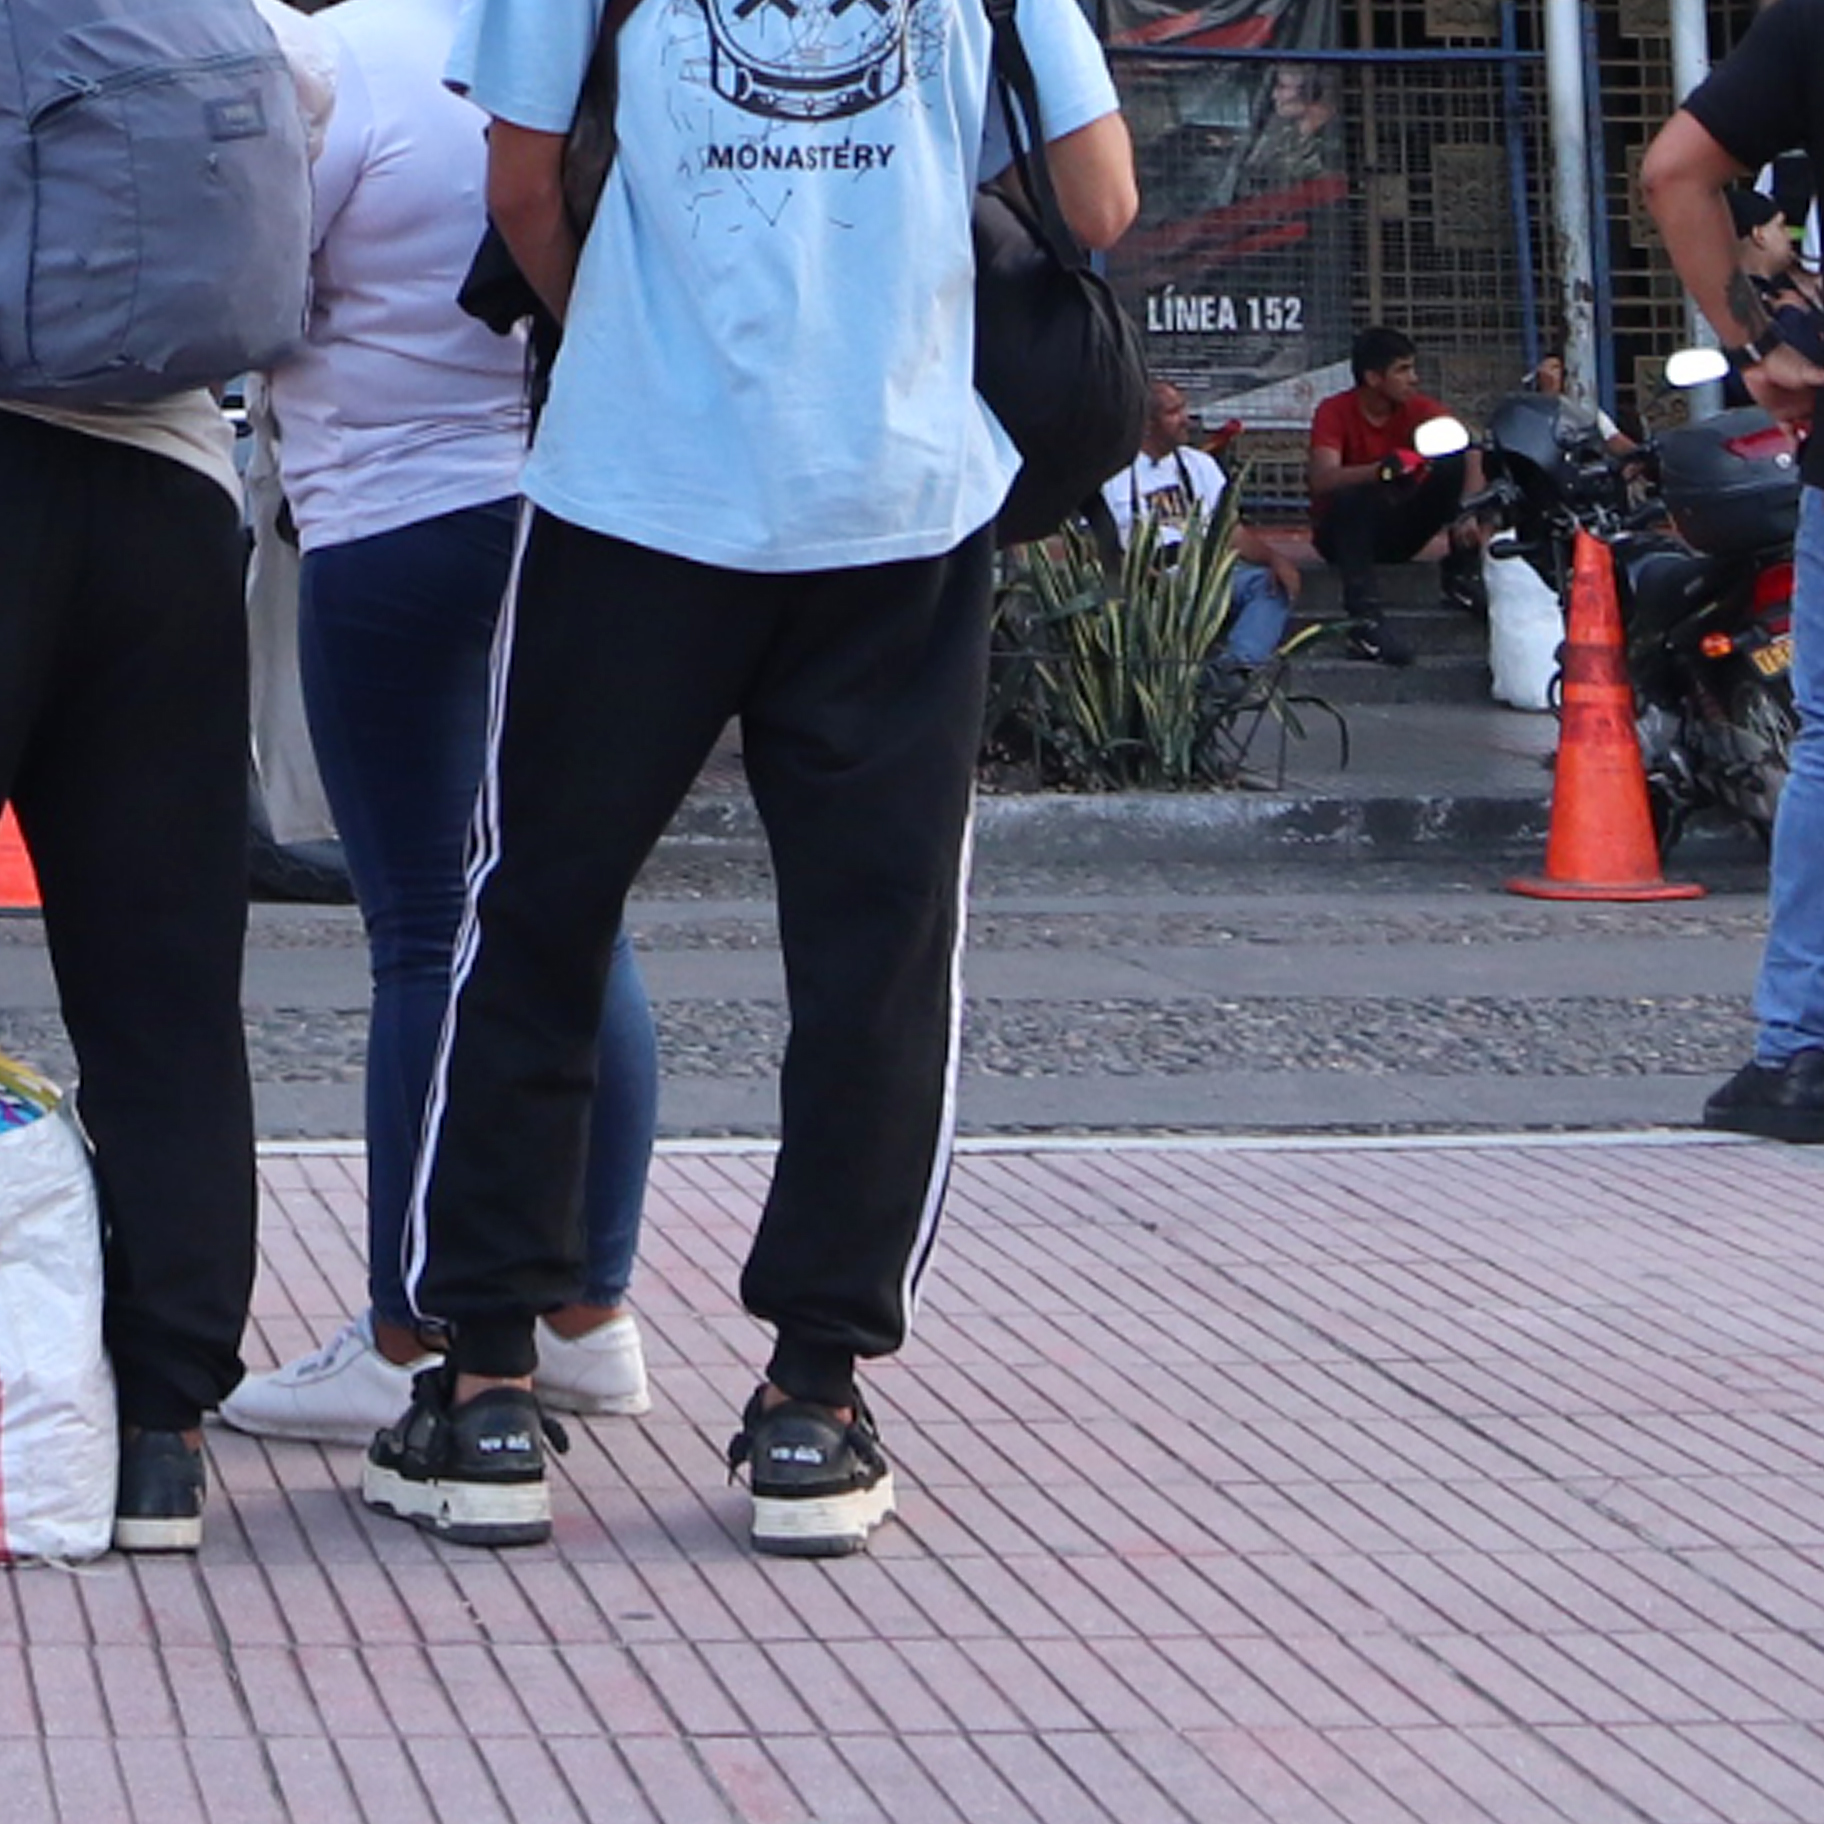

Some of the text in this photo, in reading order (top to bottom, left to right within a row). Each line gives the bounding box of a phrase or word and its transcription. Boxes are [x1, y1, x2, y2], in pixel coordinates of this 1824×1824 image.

[706, 143, 896, 170] MONASTERY
[1147, 283, 1305, 331] LÍNEA 152
